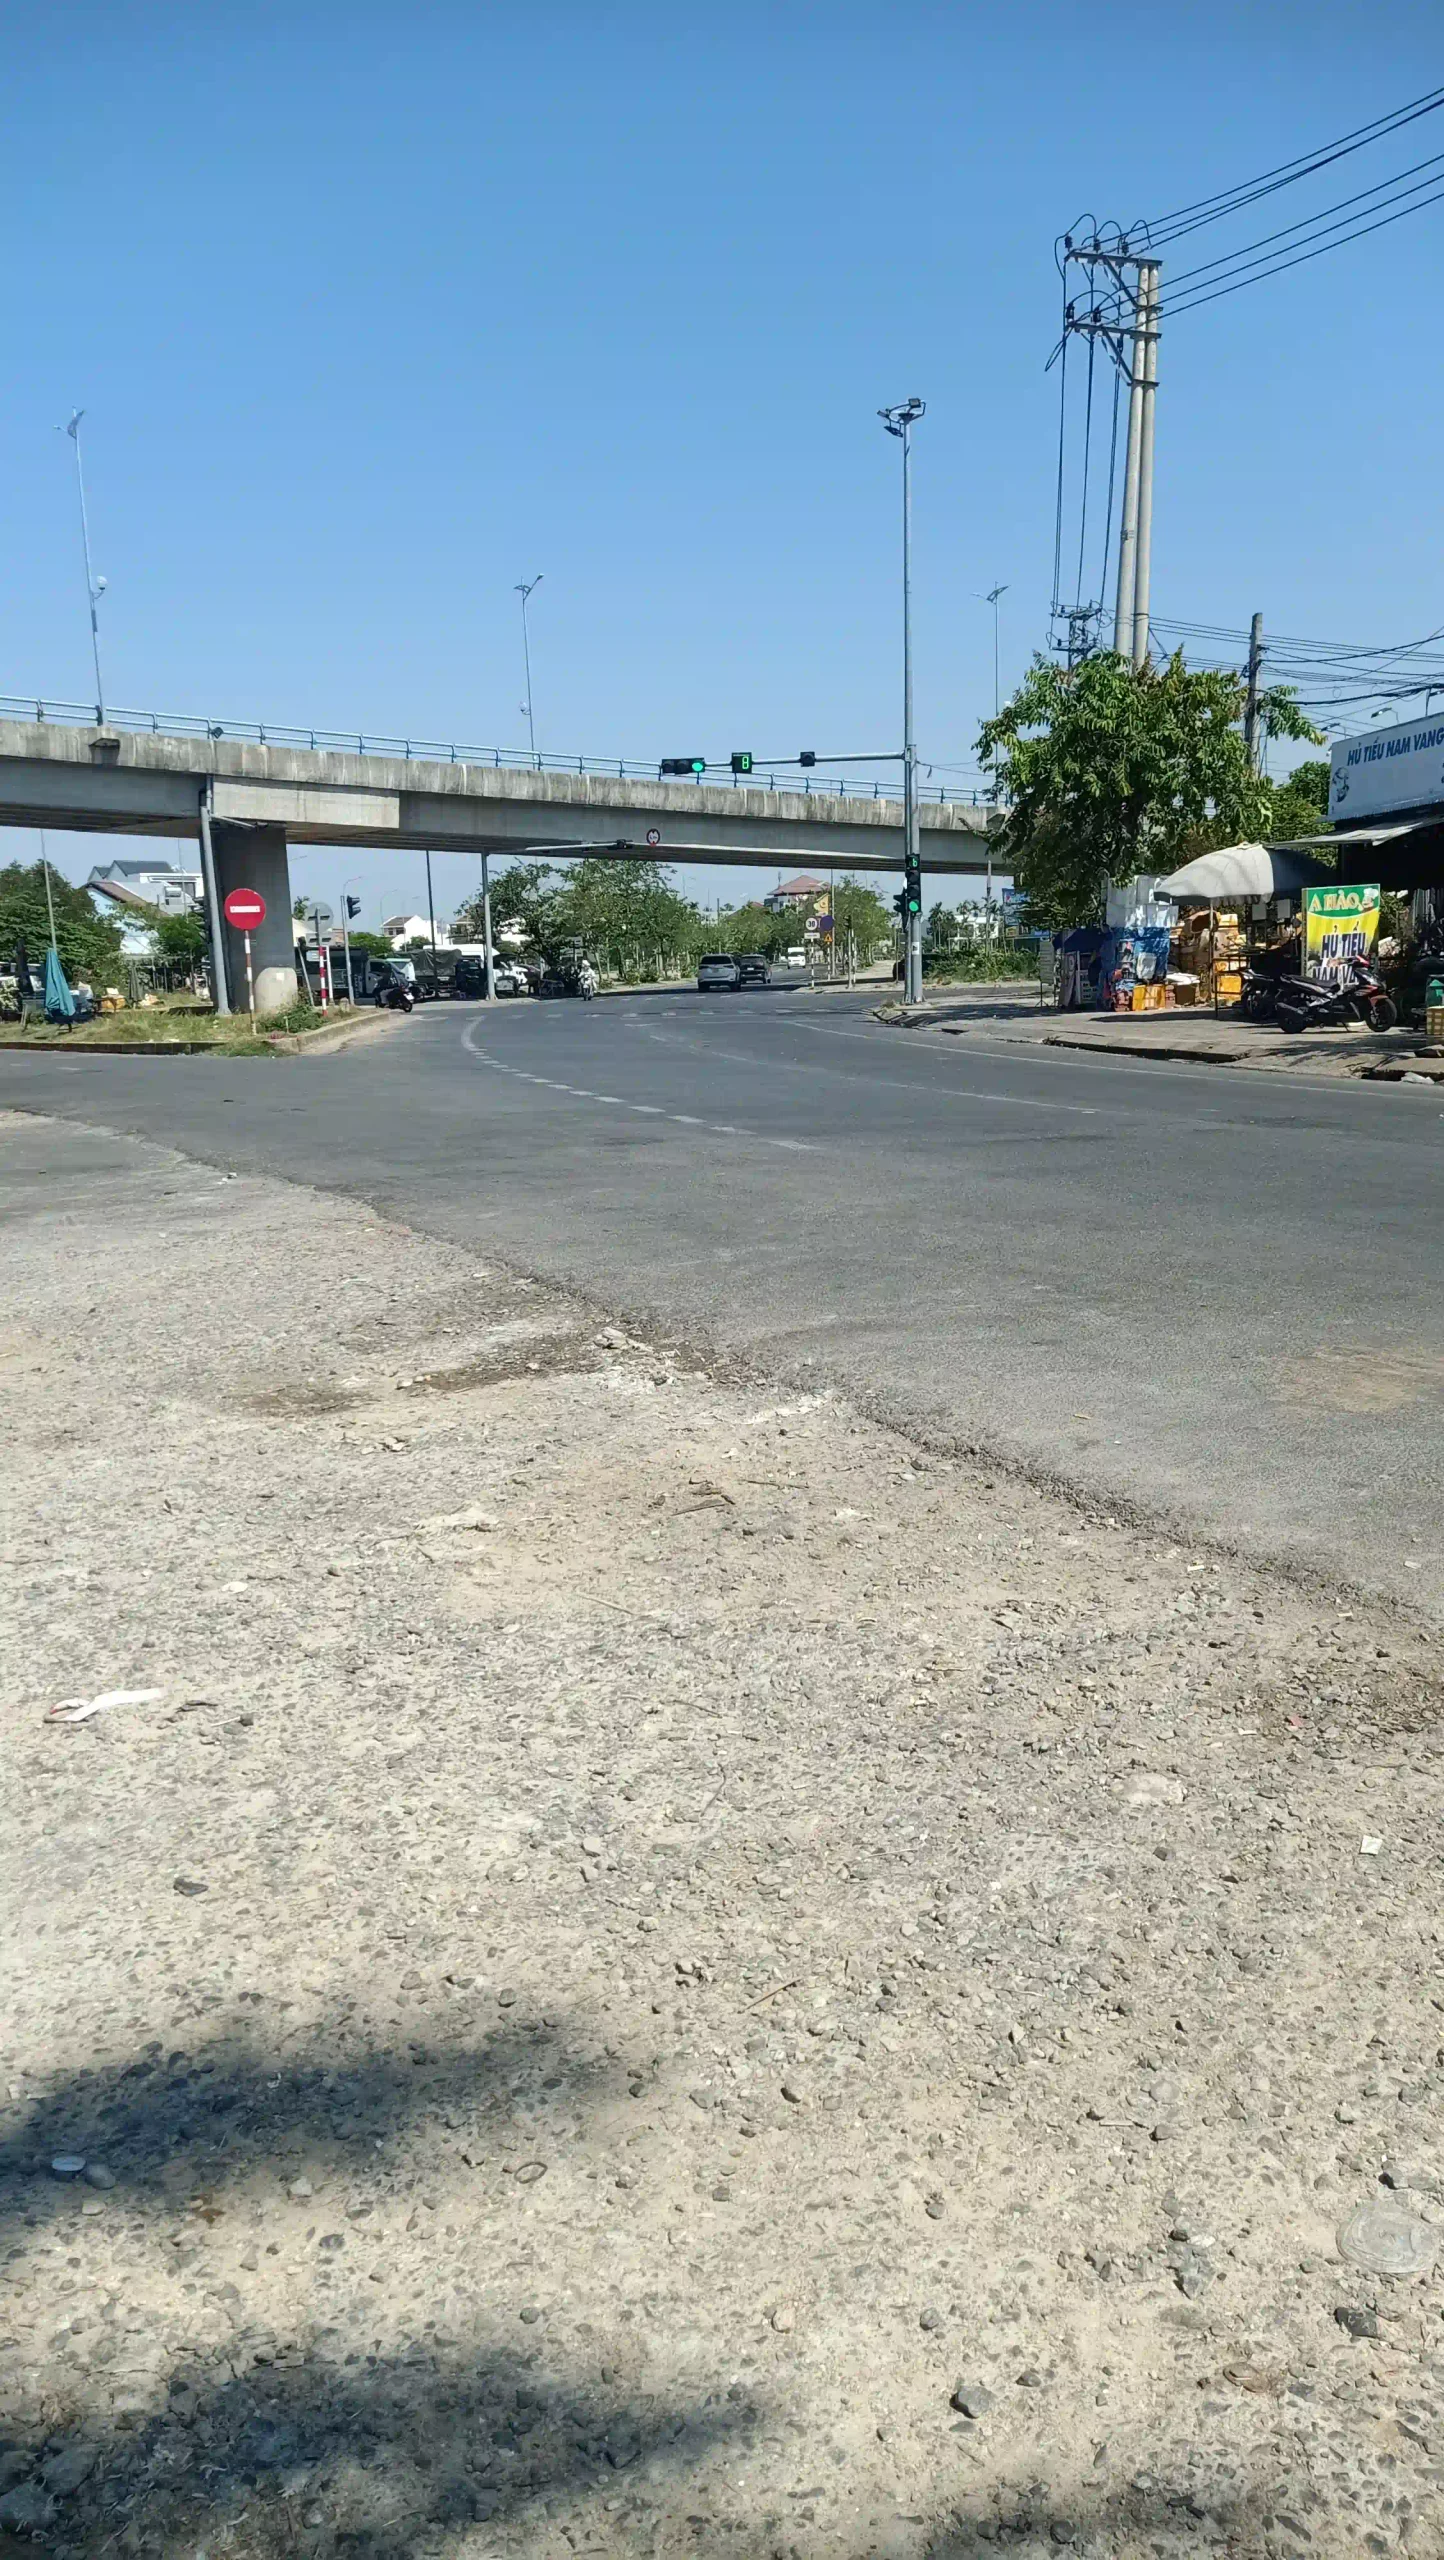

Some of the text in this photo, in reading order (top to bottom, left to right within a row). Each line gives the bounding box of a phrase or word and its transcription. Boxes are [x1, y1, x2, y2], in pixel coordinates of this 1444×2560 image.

[1347, 727, 1444, 766] HỦ TIẾU NAM VANG
[741, 755, 750, 770] 8
[1309, 893, 1323, 912] A
[1323, 920, 1366, 958] HỦ TIẾU
